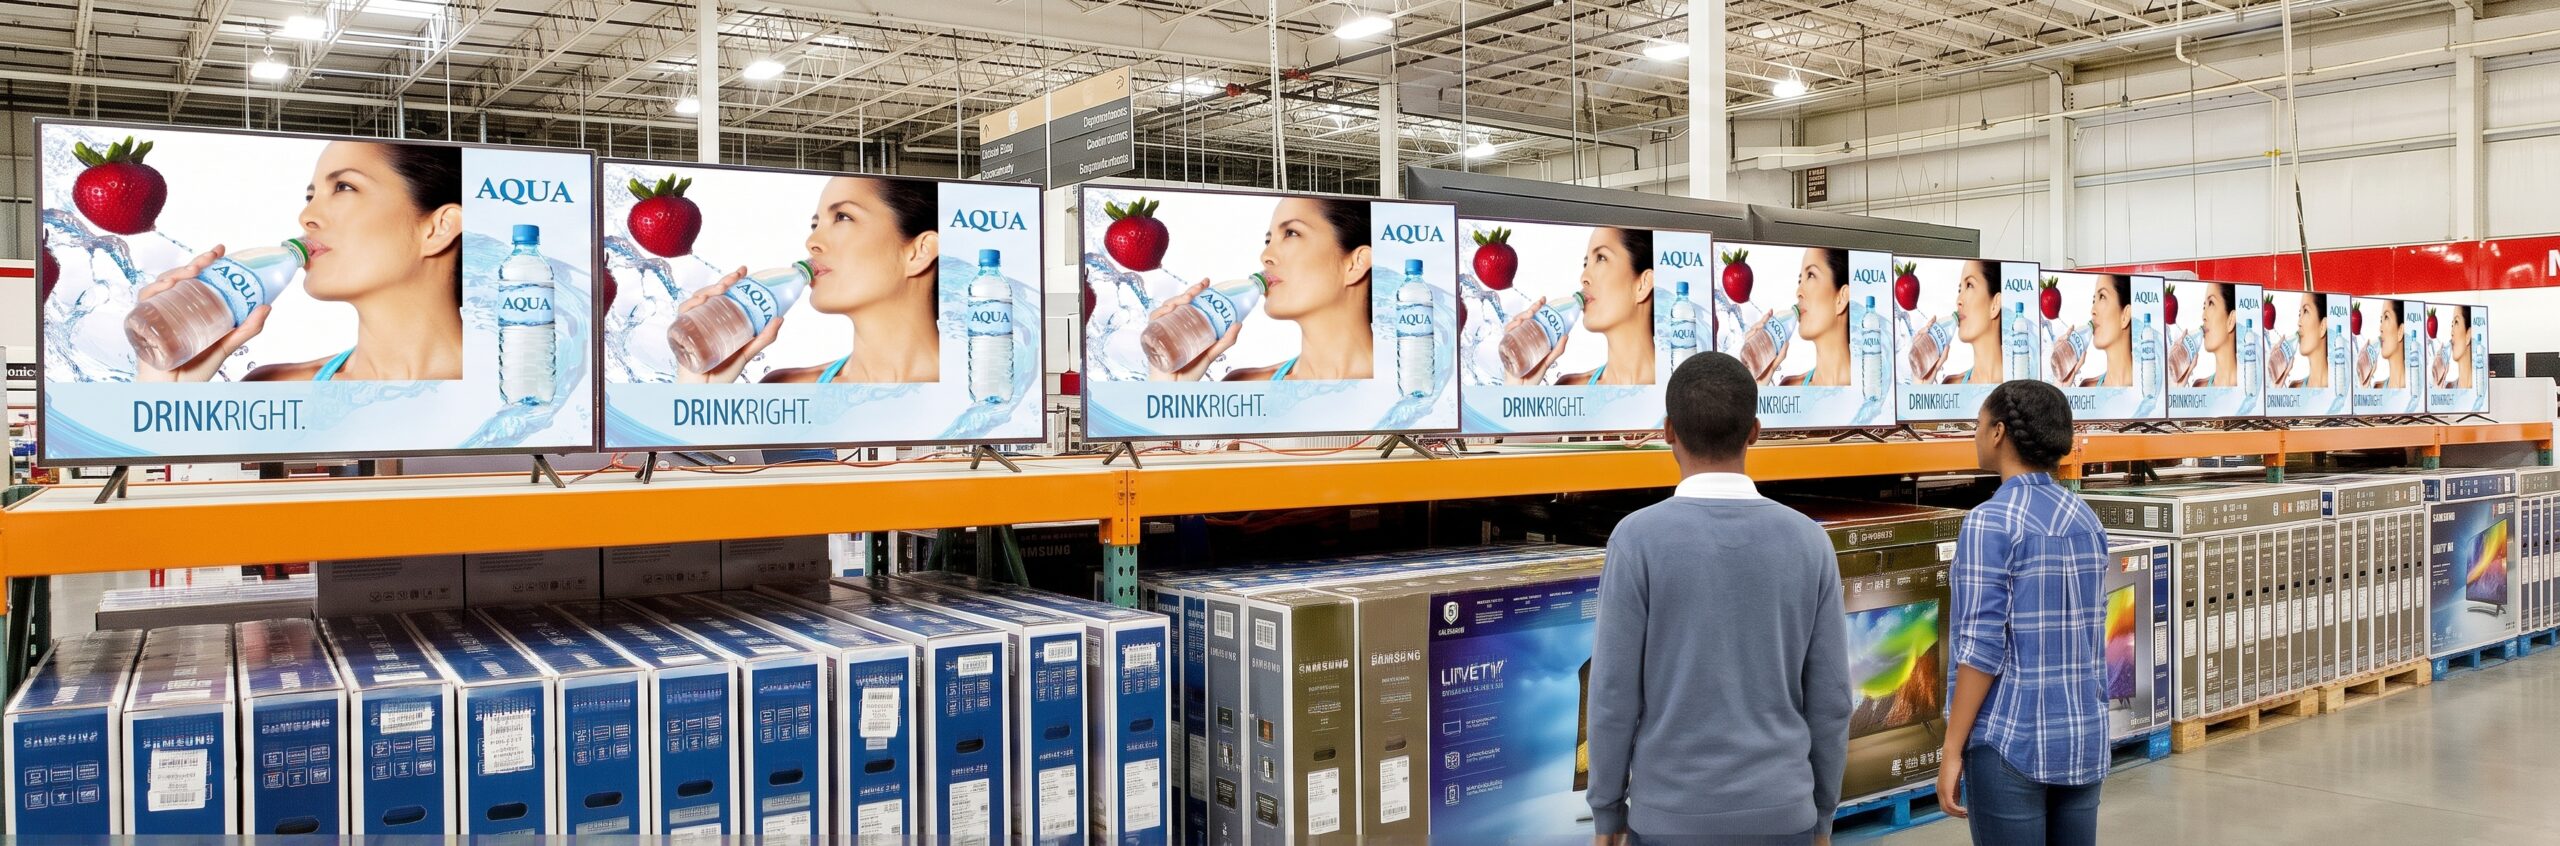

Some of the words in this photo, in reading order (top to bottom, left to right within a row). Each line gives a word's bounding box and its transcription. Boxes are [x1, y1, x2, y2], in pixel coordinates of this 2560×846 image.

[476, 178, 573, 205] AQUA
[951, 209, 1026, 232] AQUA
[1381, 224, 1443, 244] AQUA
[1660, 251, 1703, 268] AQUA
[1854, 269, 1886, 284] AQUA
[2005, 279, 2033, 292] AQUA
[212, 265, 258, 317] AQUA
[2135, 292, 2158, 304] AQUA
[501, 295, 553, 313] AQUA
[737, 282, 773, 325] AQUA
[1202, 293, 1234, 328] AQUA
[2239, 299, 2259, 310] AQUA
[2330, 306, 2347, 317] AQUA
[970, 310, 1011, 325] AQUA
[1398, 314, 1433, 326] AQUA
[1672, 330, 1696, 340] AQUA
[1148, 394, 1266, 418] DRINKRIGHT.
[1503, 396, 1585, 418] DRINKRIGHT.
[1757, 396, 1801, 414] NKRIGHT.
[2067, 395, 2097, 410] KRIGHT.
[134, 400, 305, 432] DRINKRIGHT.
[675, 399, 811, 425] DRINKRIGHT.
[1020, 544, 1071, 558] AMSUNG
